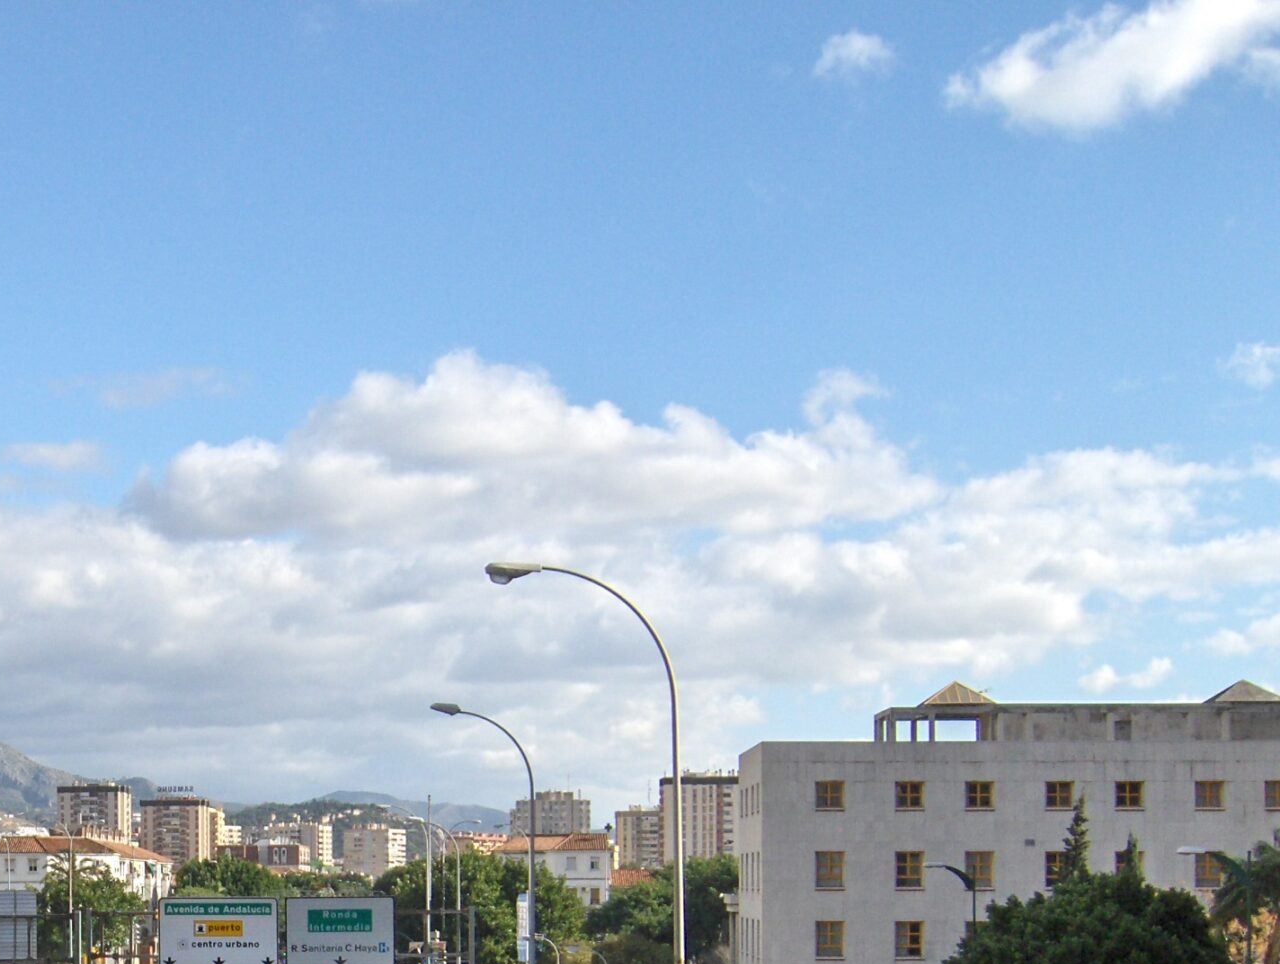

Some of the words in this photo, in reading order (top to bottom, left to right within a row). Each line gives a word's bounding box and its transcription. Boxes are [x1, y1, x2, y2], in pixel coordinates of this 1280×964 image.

[166, 905, 205, 913] Avenida
[208, 905, 220, 913] de
[322, 911, 358, 919] Ronda
[208, 924, 241, 932] puerto
[309, 923, 371, 931] Intermedia
[191, 940, 223, 948] centro
[225, 940, 260, 948] urbano
[301, 944, 343, 952] Sanitaria
